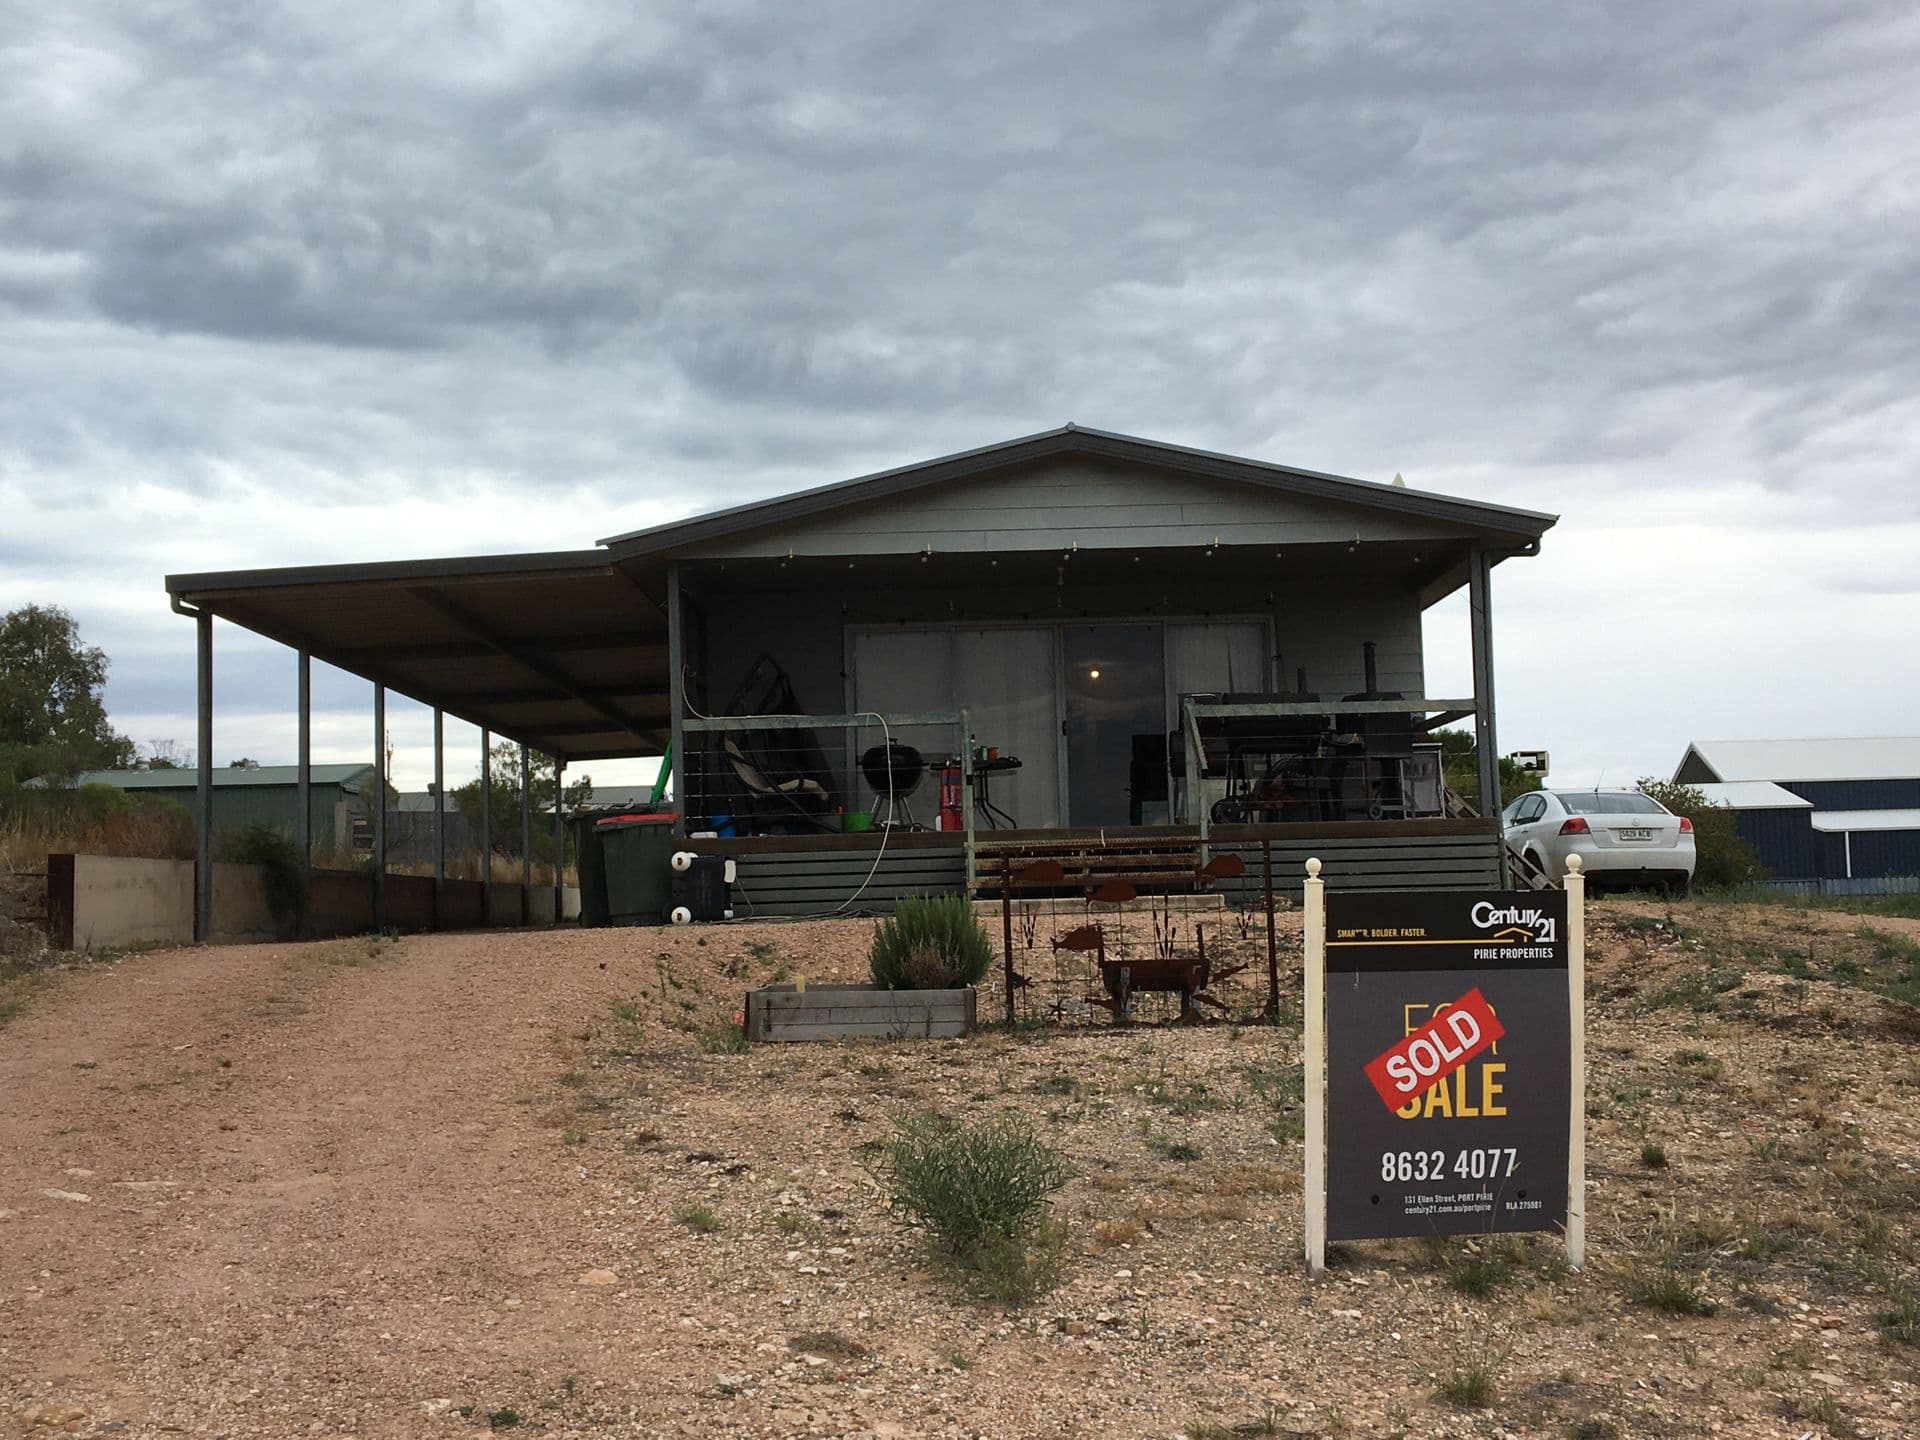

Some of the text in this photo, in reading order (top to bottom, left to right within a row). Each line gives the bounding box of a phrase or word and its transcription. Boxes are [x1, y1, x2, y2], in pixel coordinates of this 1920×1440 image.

[1471, 901, 1542, 928] Century
[1371, 928, 1399, 938] BOLDER.
[1401, 927, 1427, 937] FASTER.
[1535, 918, 1555, 942] 21
[1474, 947, 1554, 959] PIRIE PROPERTIES
[1386, 1010, 1480, 1092] SOLD
[1381, 1148, 1517, 1182] 8632 4077
[1404, 1195, 1416, 1204] 131
[1457, 1193, 1475, 1202] PORT
